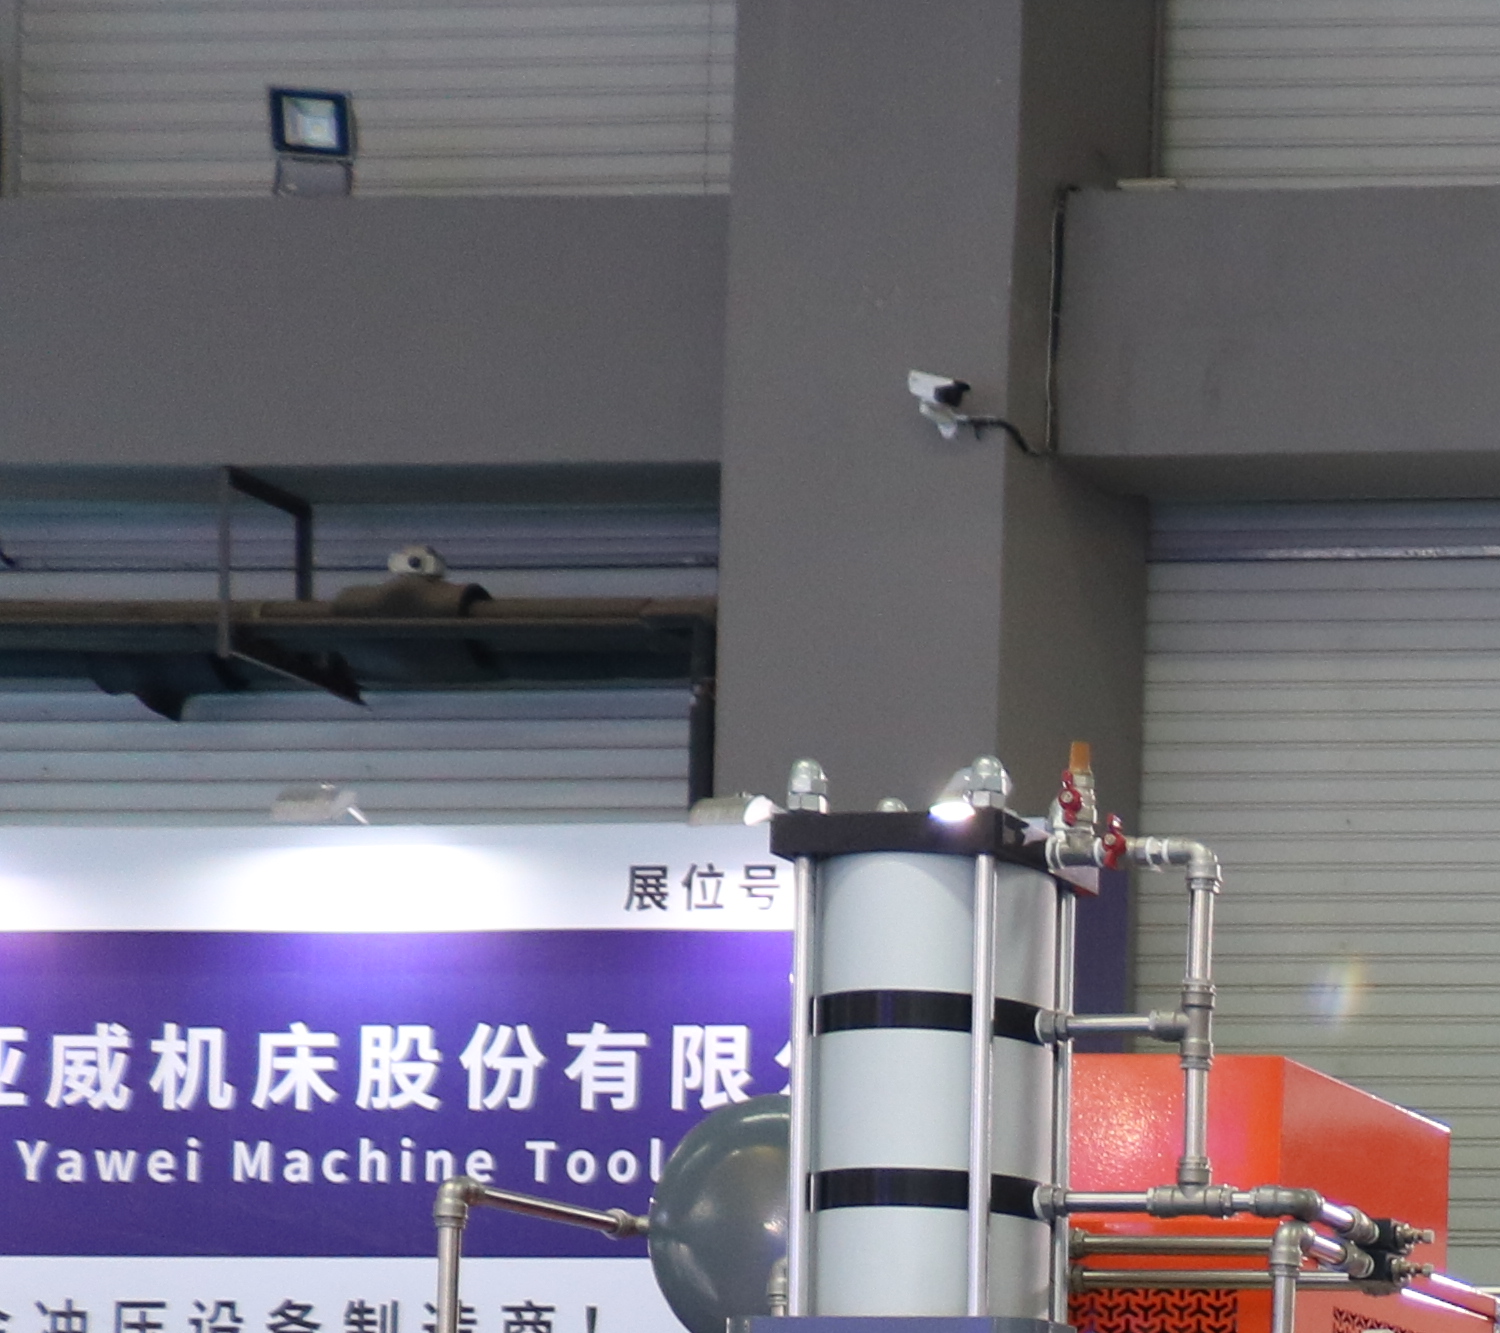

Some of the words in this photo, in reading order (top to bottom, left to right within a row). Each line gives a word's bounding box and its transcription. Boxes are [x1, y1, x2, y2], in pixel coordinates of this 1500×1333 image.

[625, 863, 780, 912] 展位号
[0, 1023, 794, 1112] 威机床股份有限
[16, 1140, 203, 1184] Yawei
[232, 1140, 497, 1184] Machine
